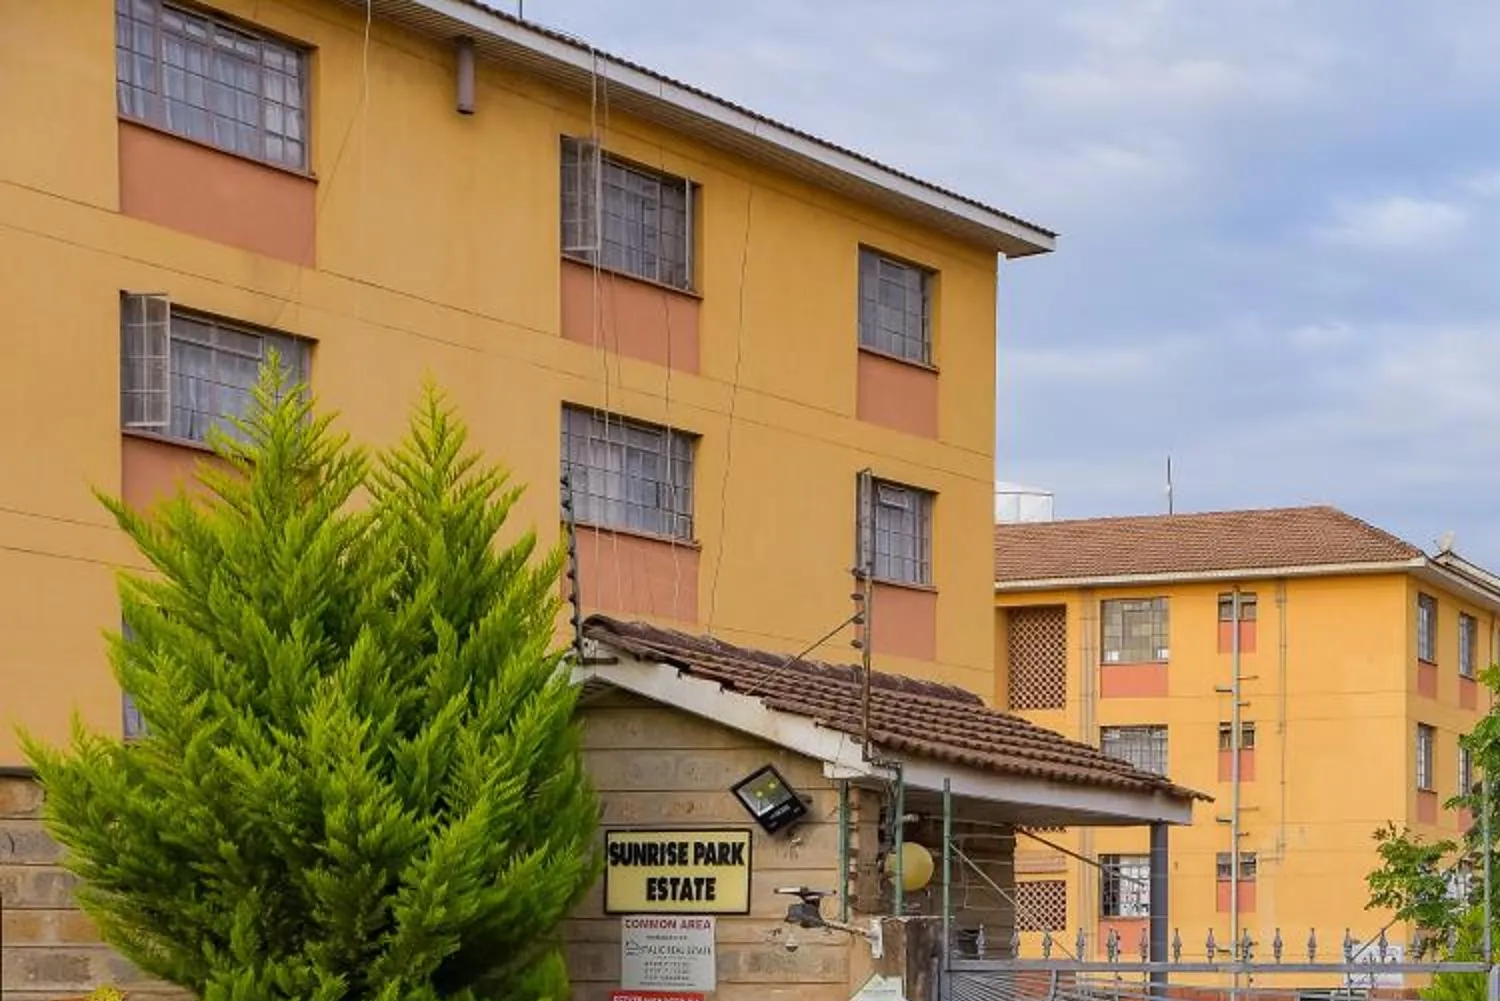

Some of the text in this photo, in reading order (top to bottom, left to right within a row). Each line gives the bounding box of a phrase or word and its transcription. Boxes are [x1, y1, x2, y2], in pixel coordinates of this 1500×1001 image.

[609, 841, 745, 866] SUNRISE PARK
[646, 877, 716, 901] ESTATE
[624, 918, 711, 929] COMMON AREA
